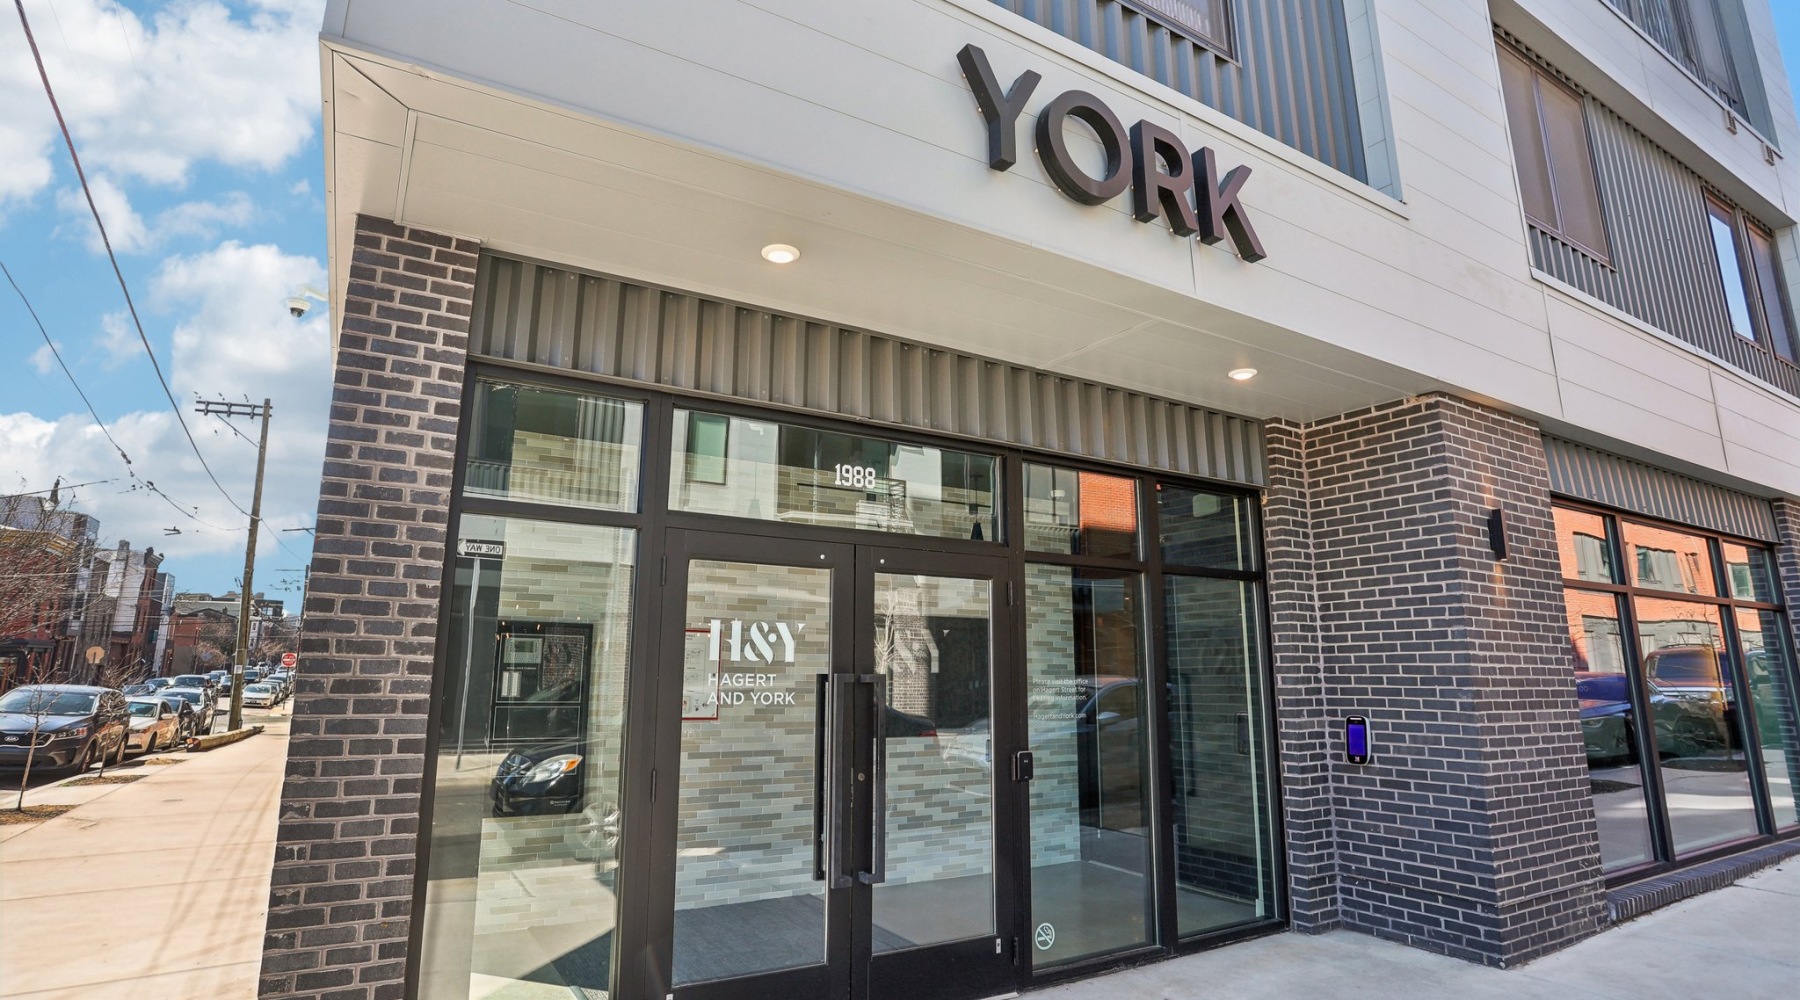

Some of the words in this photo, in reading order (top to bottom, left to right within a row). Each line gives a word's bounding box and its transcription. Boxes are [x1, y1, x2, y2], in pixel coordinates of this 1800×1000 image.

[956, 43, 1267, 264] YORK
[834, 463, 876, 489] 1988
[709, 619, 806, 665] H&Y
[707, 672, 777, 687] HAGERT
[706, 691, 745, 705] AND
[750, 691, 796, 705] YORK
